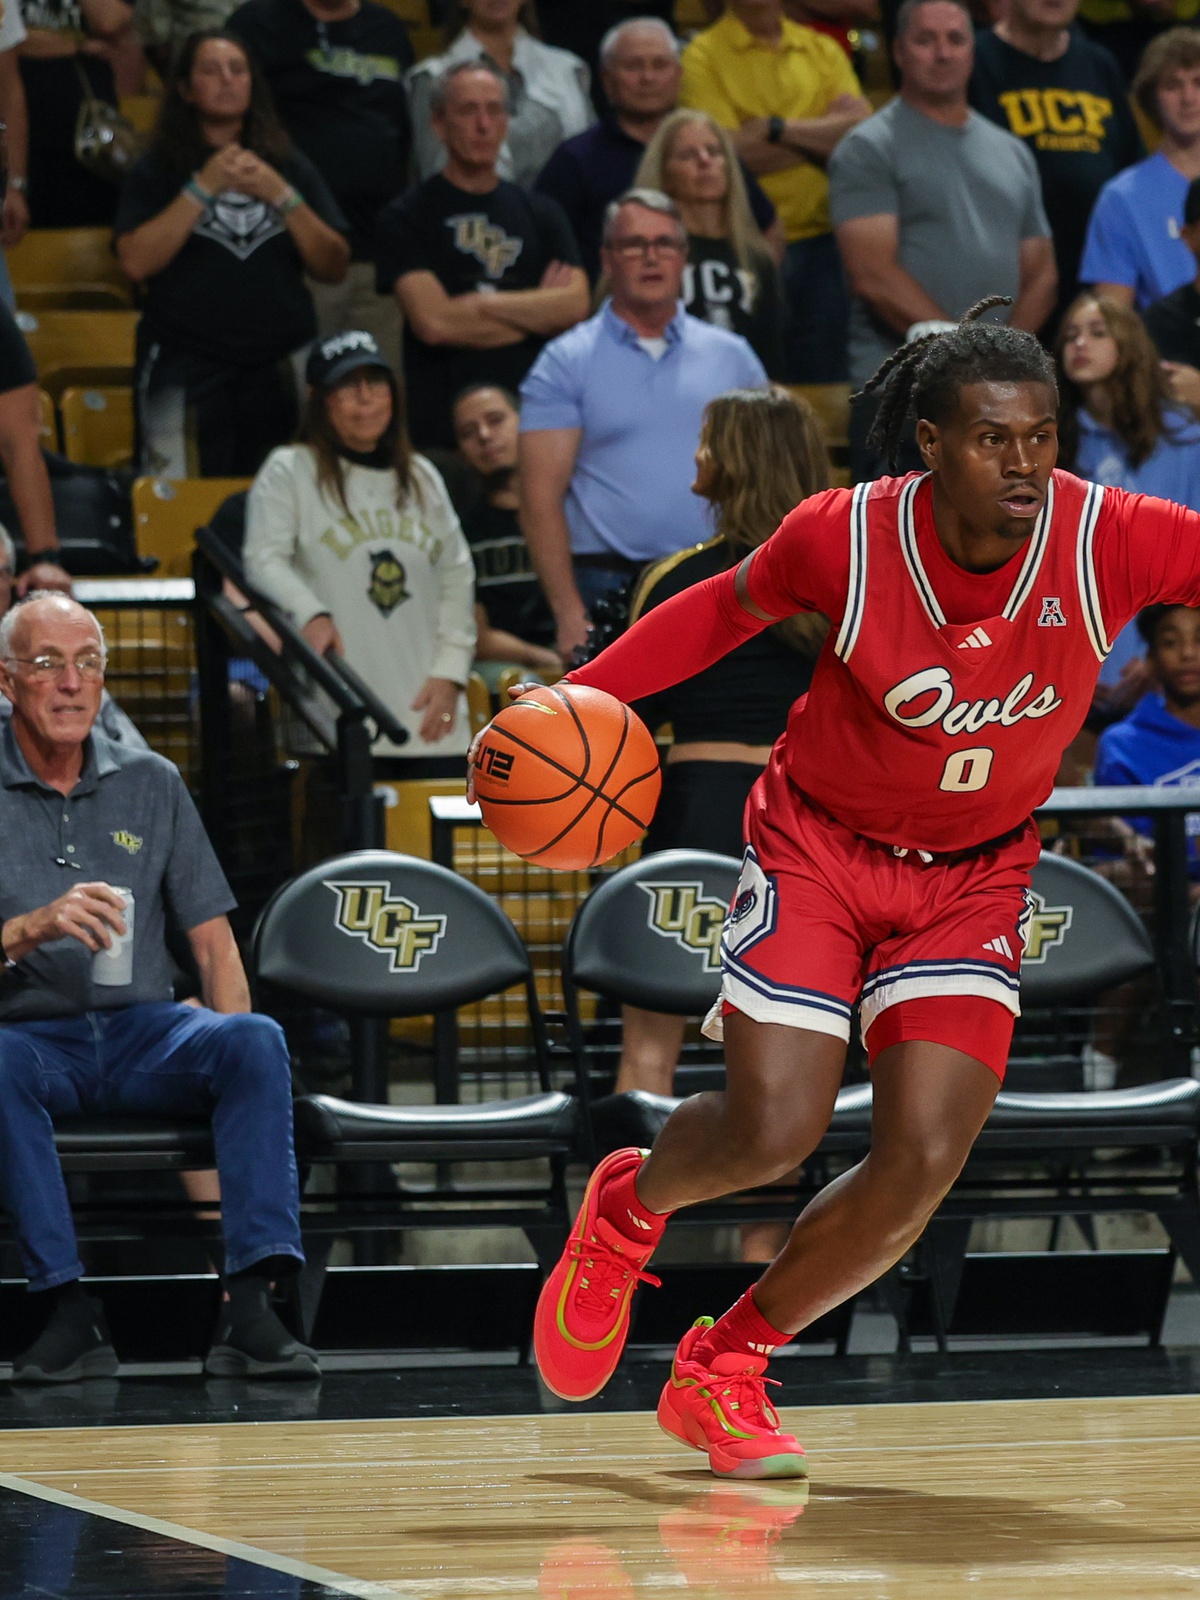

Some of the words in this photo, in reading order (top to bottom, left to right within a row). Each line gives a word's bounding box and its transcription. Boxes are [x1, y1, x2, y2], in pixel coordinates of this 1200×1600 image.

[998, 87, 1113, 138] UCF
[445, 213, 523, 279] UCF
[320, 507, 444, 567] KNIGHTS
[883, 665, 1063, 736] Owls
[938, 745, 995, 793] 0
[110, 829, 144, 856] UCF
[324, 881, 448, 973] UCF
